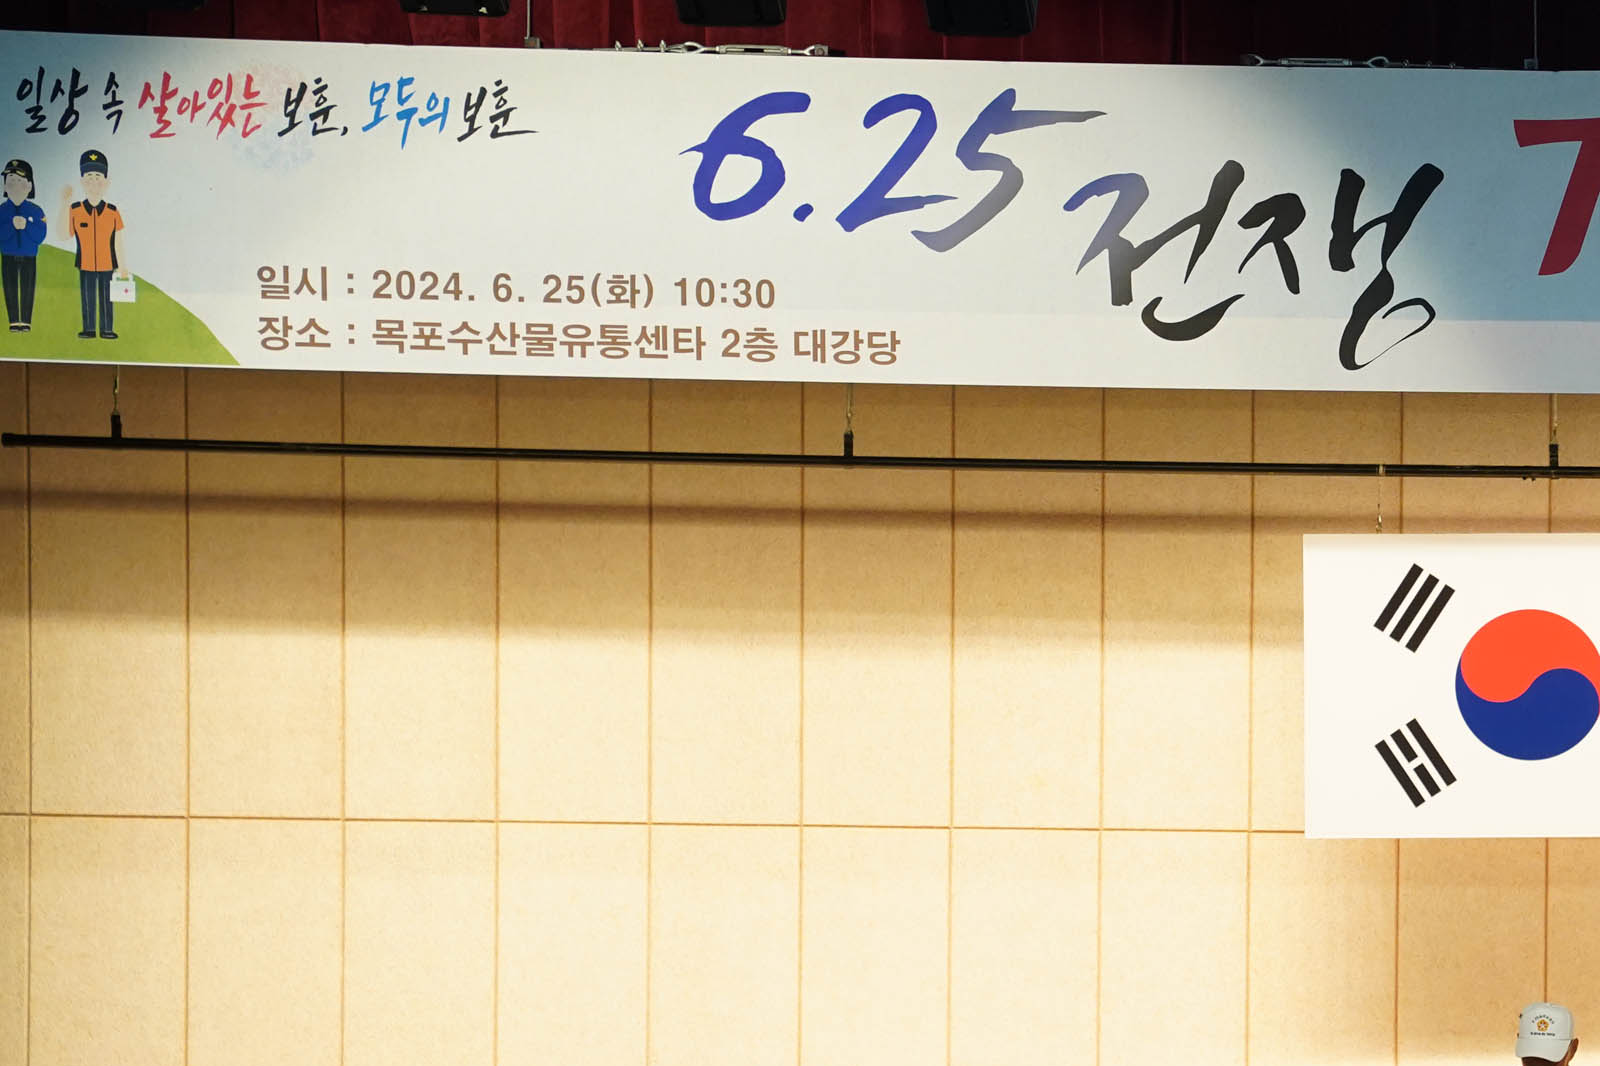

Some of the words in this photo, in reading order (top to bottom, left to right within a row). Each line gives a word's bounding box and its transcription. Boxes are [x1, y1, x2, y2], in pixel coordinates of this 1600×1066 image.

[16, 65, 88, 135] 일상
[101, 78, 124, 134] 속
[137, 71, 268, 140] 살아있는
[279, 77, 349, 137] 보훈,
[362, 76, 450, 150] 모두의
[457, 79, 538, 142] 보훈
[678, 87, 1107, 253] 6.25
[1062, 159, 1445, 371] 전쟁
[257, 265, 328, 302] 일시
[542, 273, 654, 309] 25(화)
[674, 278, 776, 309] 10:30
[258, 316, 331, 351] 장소
[372, 319, 706, 361] 목포수산물유통센타
[720, 328, 779, 363] 2층
[793, 329, 901, 366] 대강당
